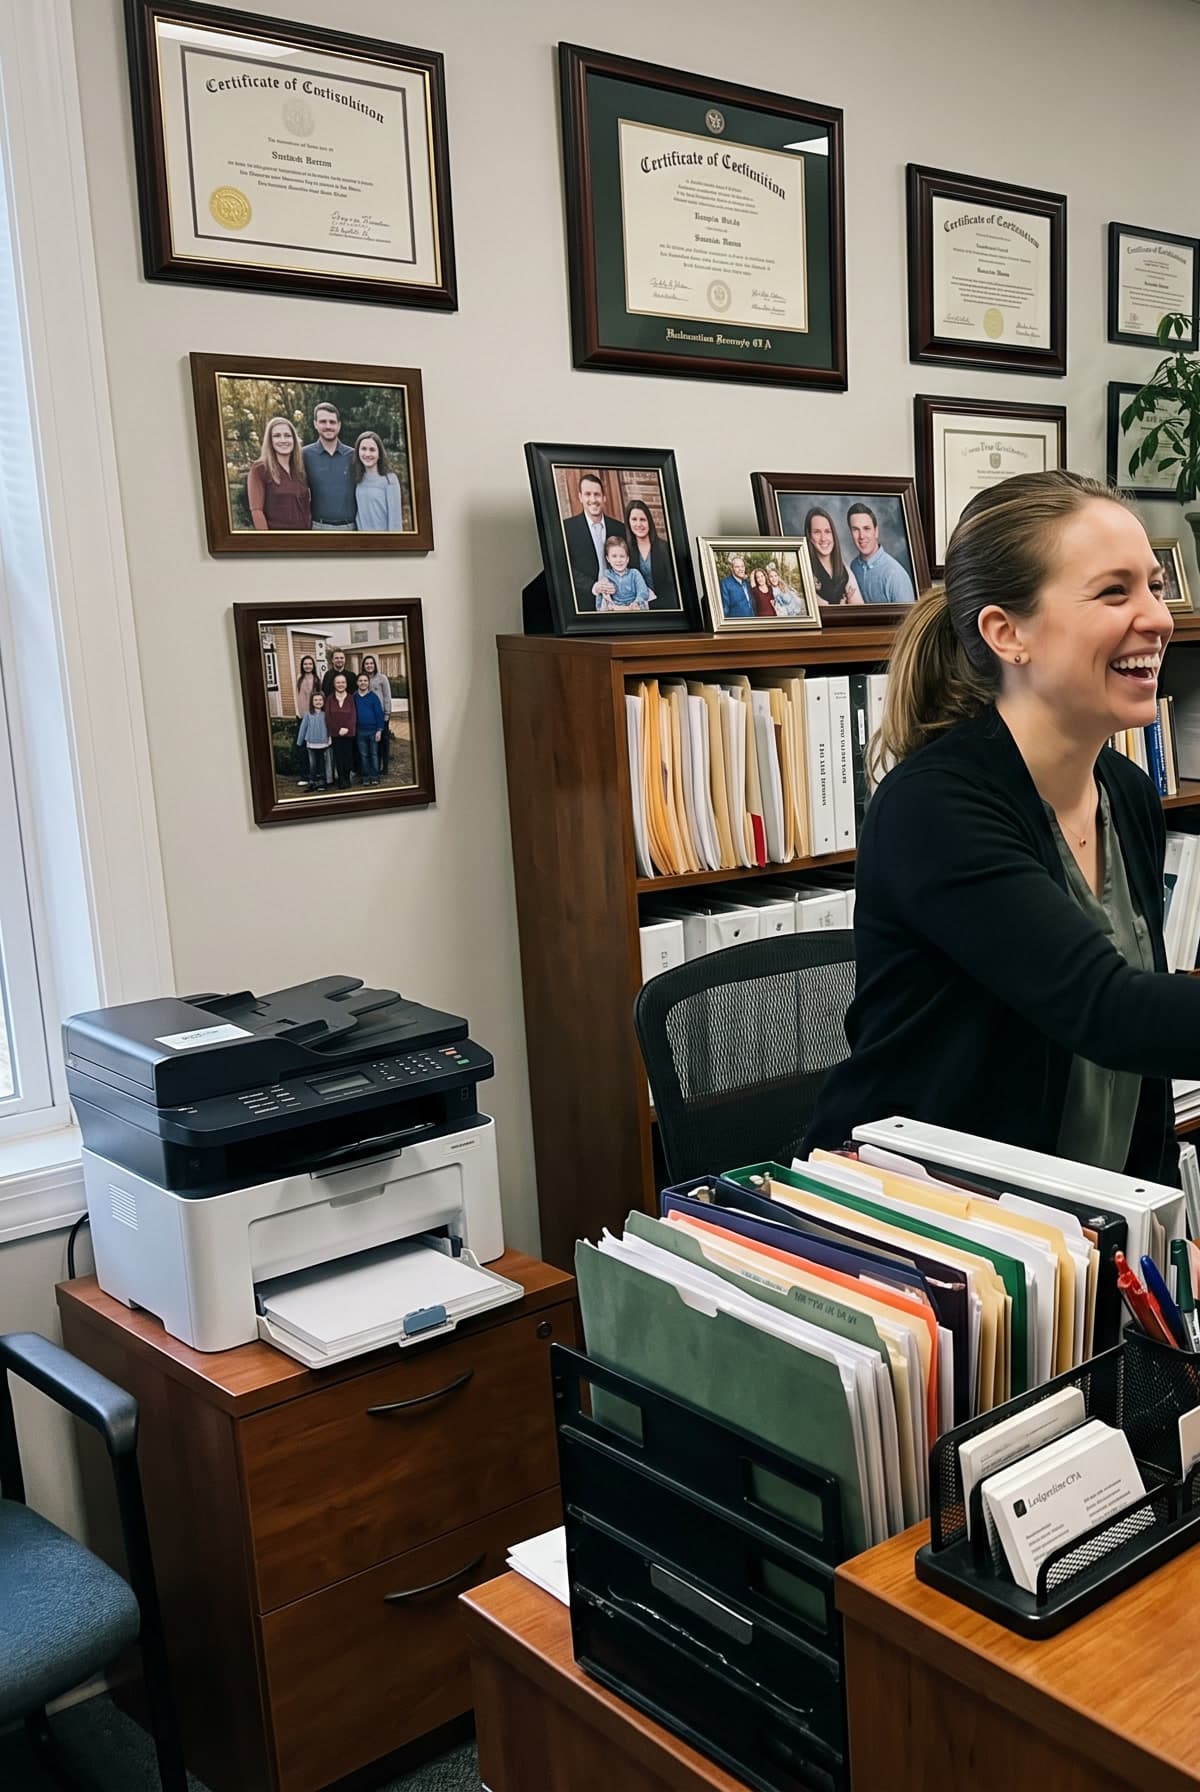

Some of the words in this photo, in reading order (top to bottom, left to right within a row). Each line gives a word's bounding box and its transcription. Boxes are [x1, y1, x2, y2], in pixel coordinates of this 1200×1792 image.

[205, 74, 280, 93] Certificate
[284, 78, 298, 91] of
[640, 151, 703, 174] Certificate
[707, 152, 719, 167] of
